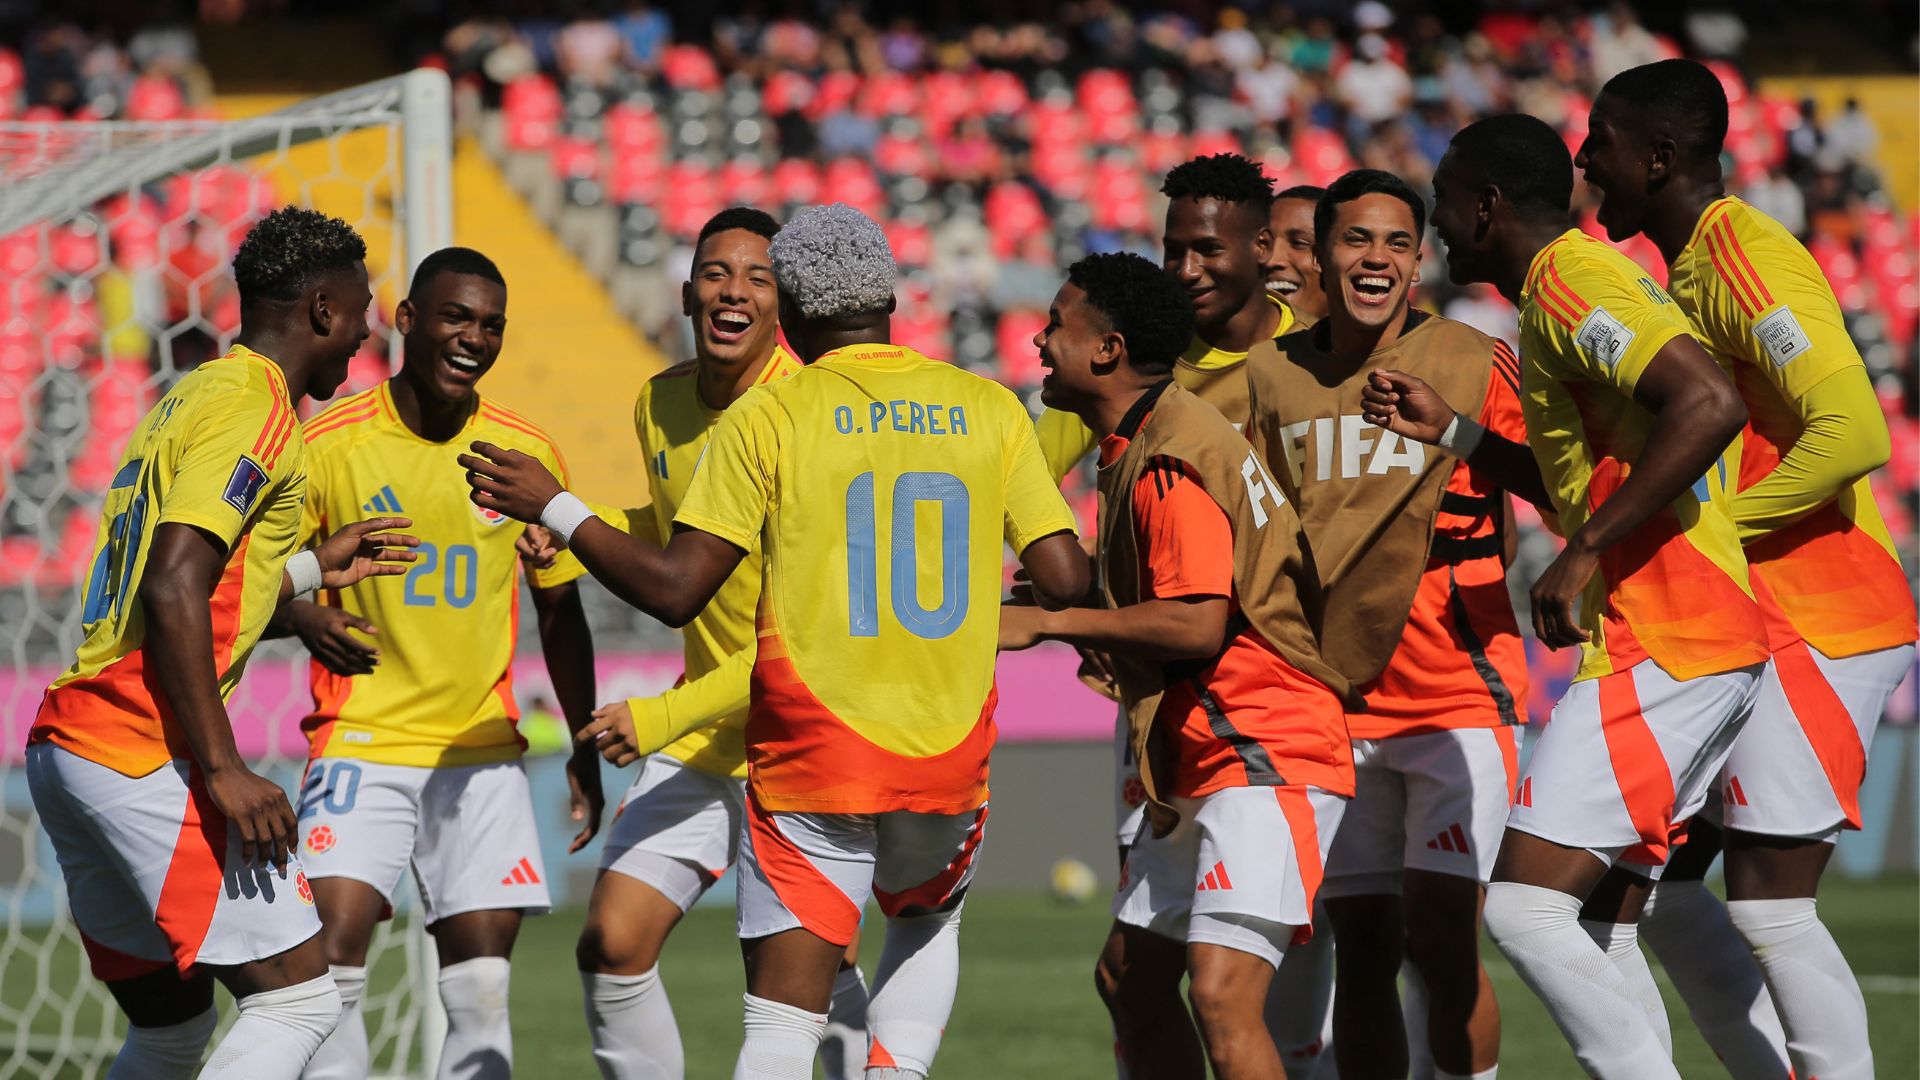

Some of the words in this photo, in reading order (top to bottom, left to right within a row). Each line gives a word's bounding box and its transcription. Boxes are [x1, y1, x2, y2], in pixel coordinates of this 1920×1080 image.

[1593, 323, 1610, 348] UNITES
[1763, 318, 1785, 335] FOOTBALL
[1766, 323, 1790, 343] UNITES
[854, 350, 905, 360] COLOMBIA
[1280, 415, 1425, 488] FIFA
[404, 542, 478, 608] 20
[846, 471, 969, 639] 10
[297, 761, 362, 821] 20
